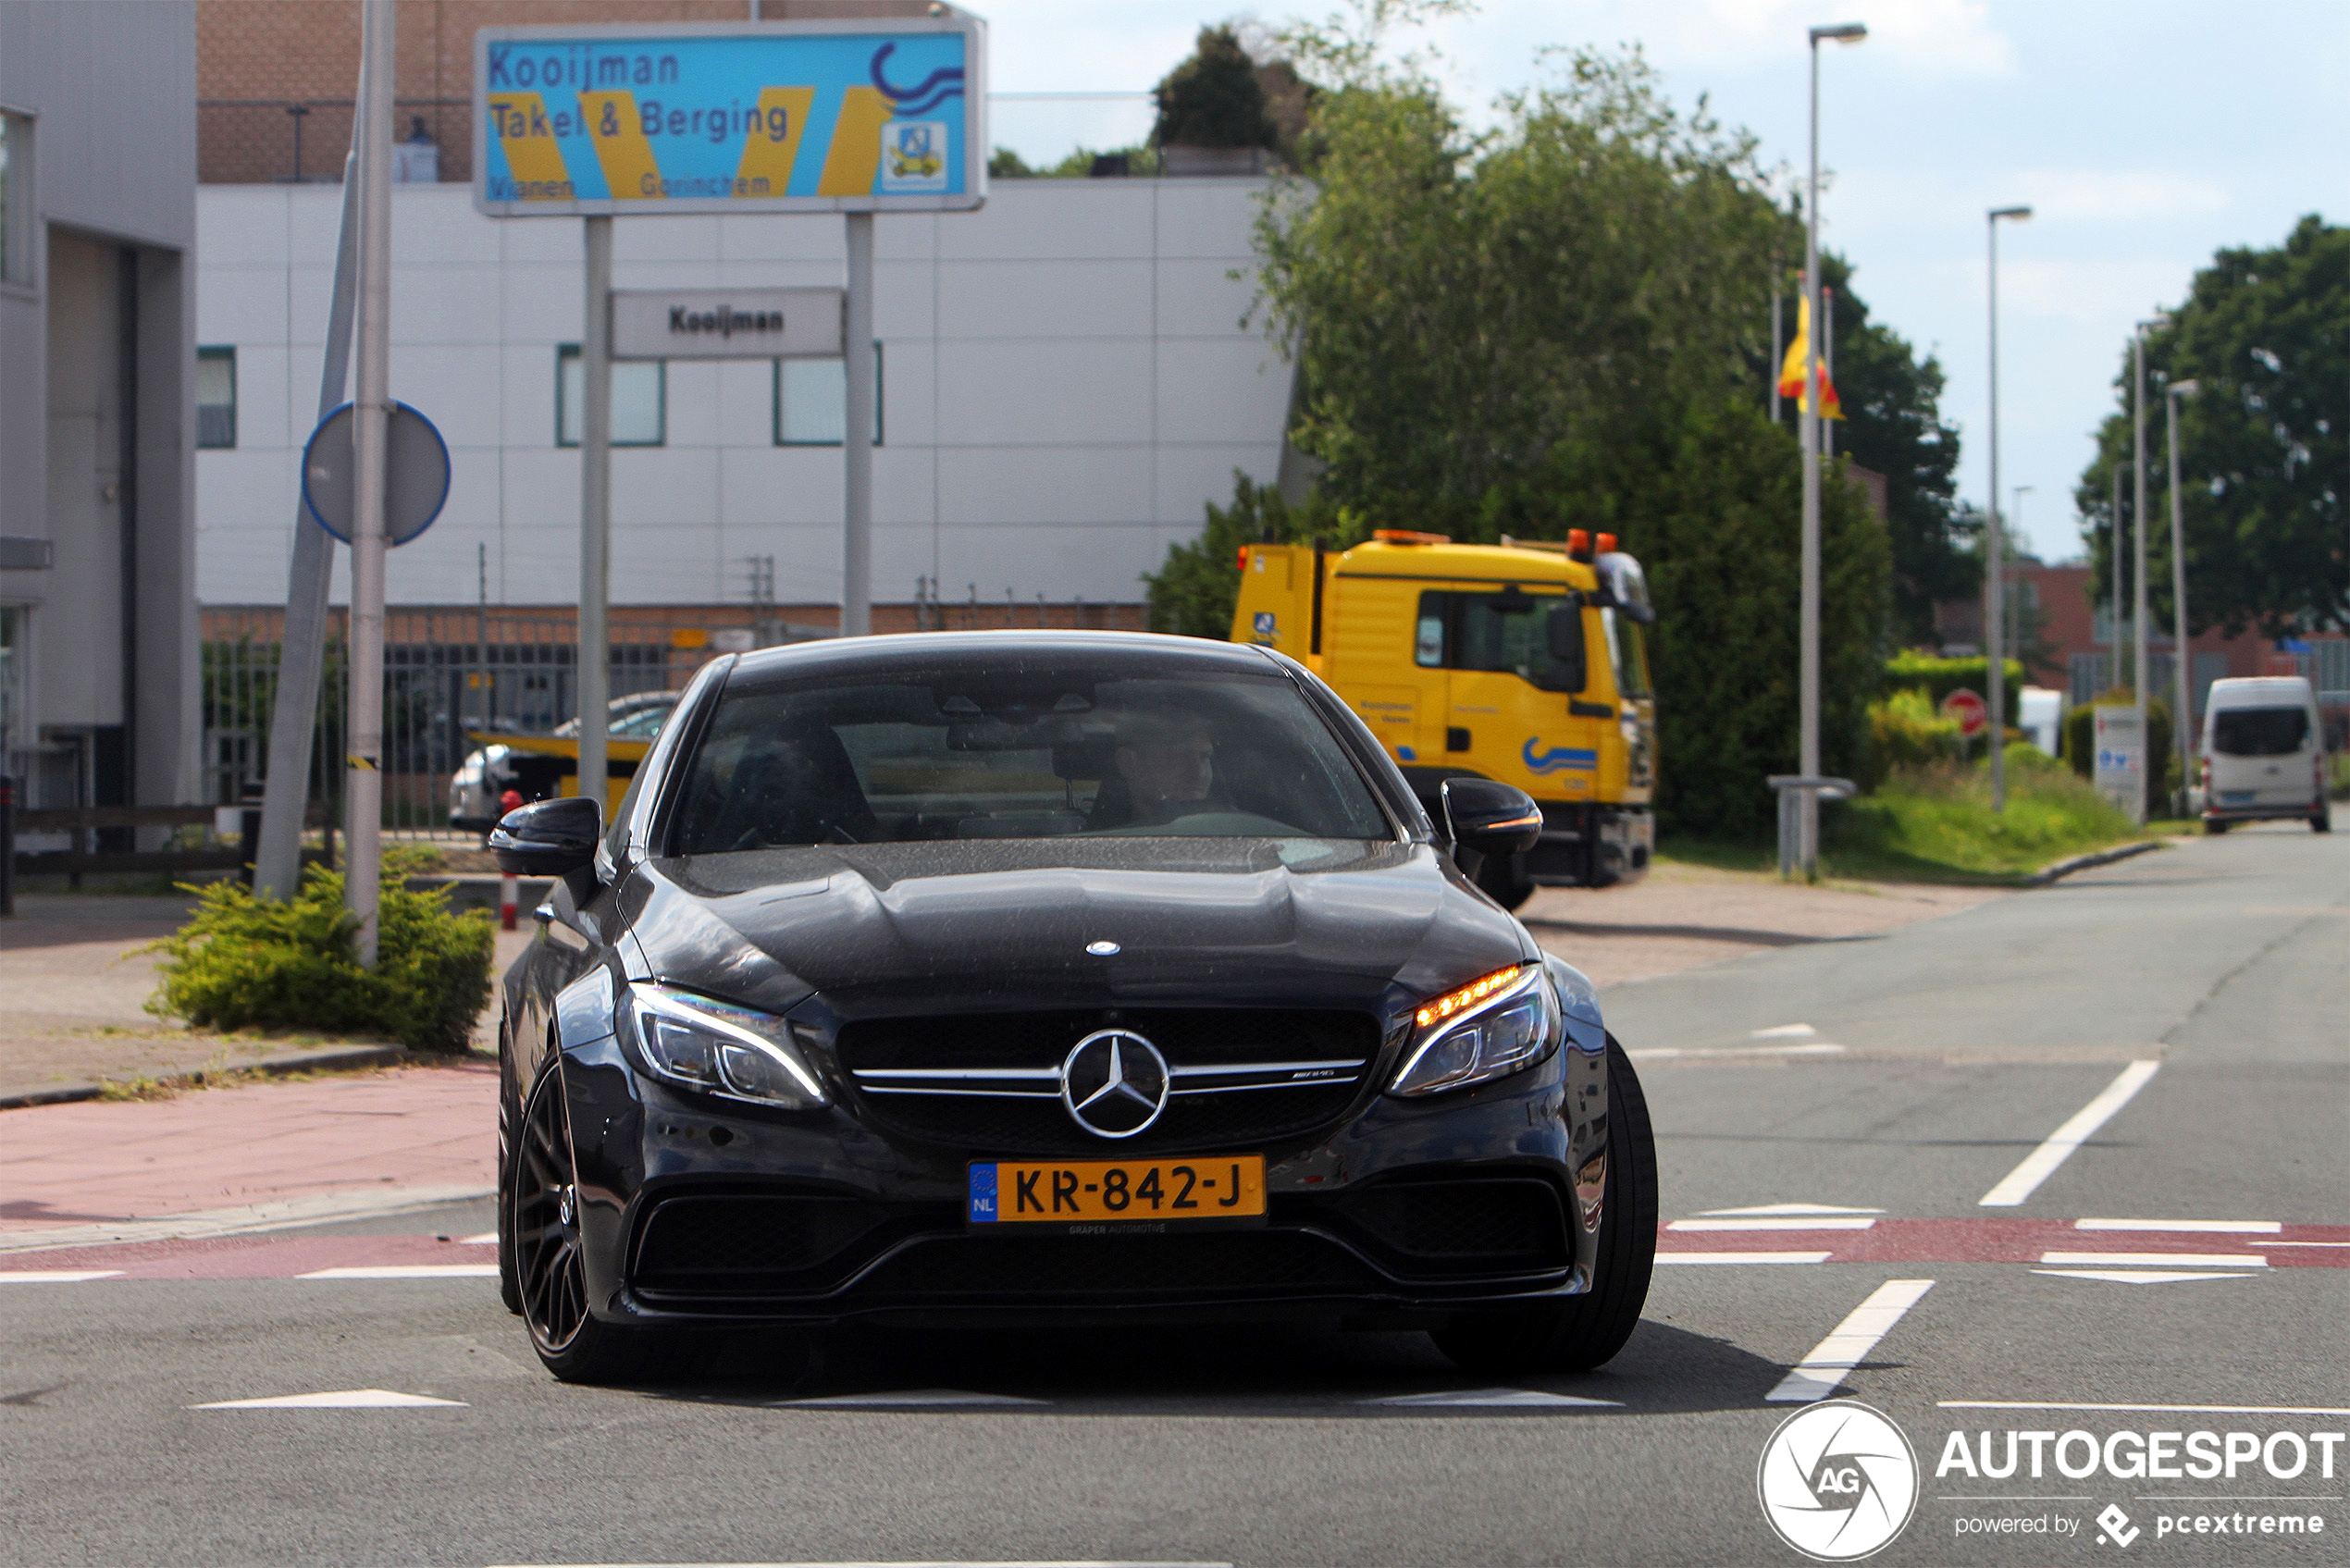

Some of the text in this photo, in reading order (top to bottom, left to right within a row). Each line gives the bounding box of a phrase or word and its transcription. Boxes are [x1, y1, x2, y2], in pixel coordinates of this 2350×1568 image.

[489, 46, 679, 93] Kooijman
[489, 98, 787, 144] Takel & Berging
[489, 176, 575, 197] Vianen
[668, 305, 785, 340] Kooijman
[973, 1198, 995, 1213] NL
[1016, 1163, 1241, 1213] KR-842-J
